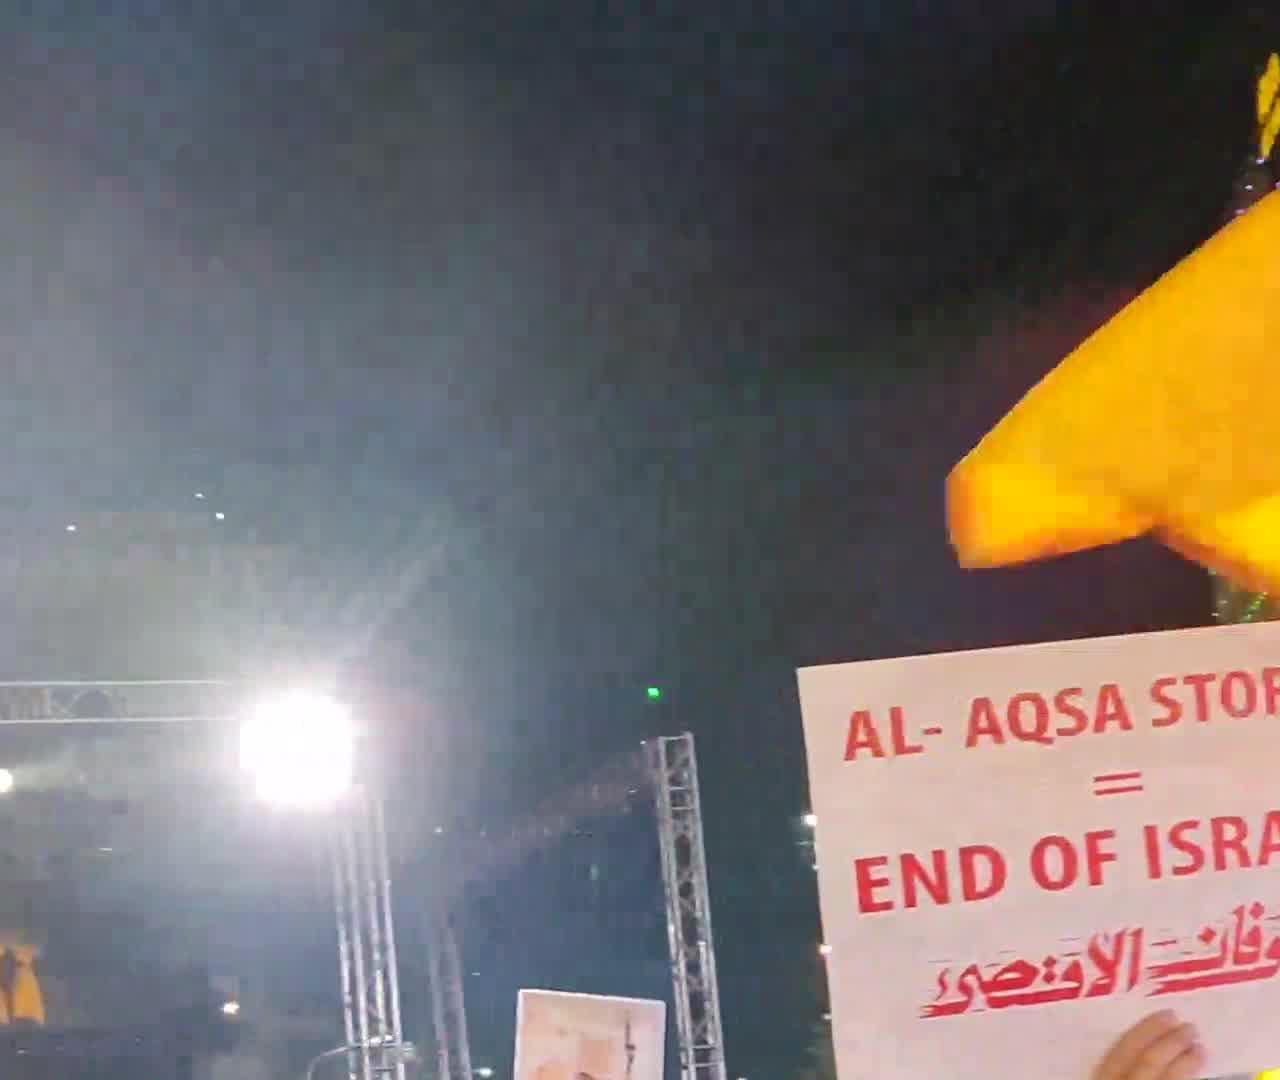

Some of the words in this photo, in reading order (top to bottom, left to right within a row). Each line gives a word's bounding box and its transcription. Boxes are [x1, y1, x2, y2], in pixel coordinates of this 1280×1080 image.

[843, 706, 943, 761] AL-
[965, 684, 1133, 748] AQSA
[1093, 771, 1144, 797] =
[853, 845, 1008, 914] END
[1029, 830, 1117, 892] OF
